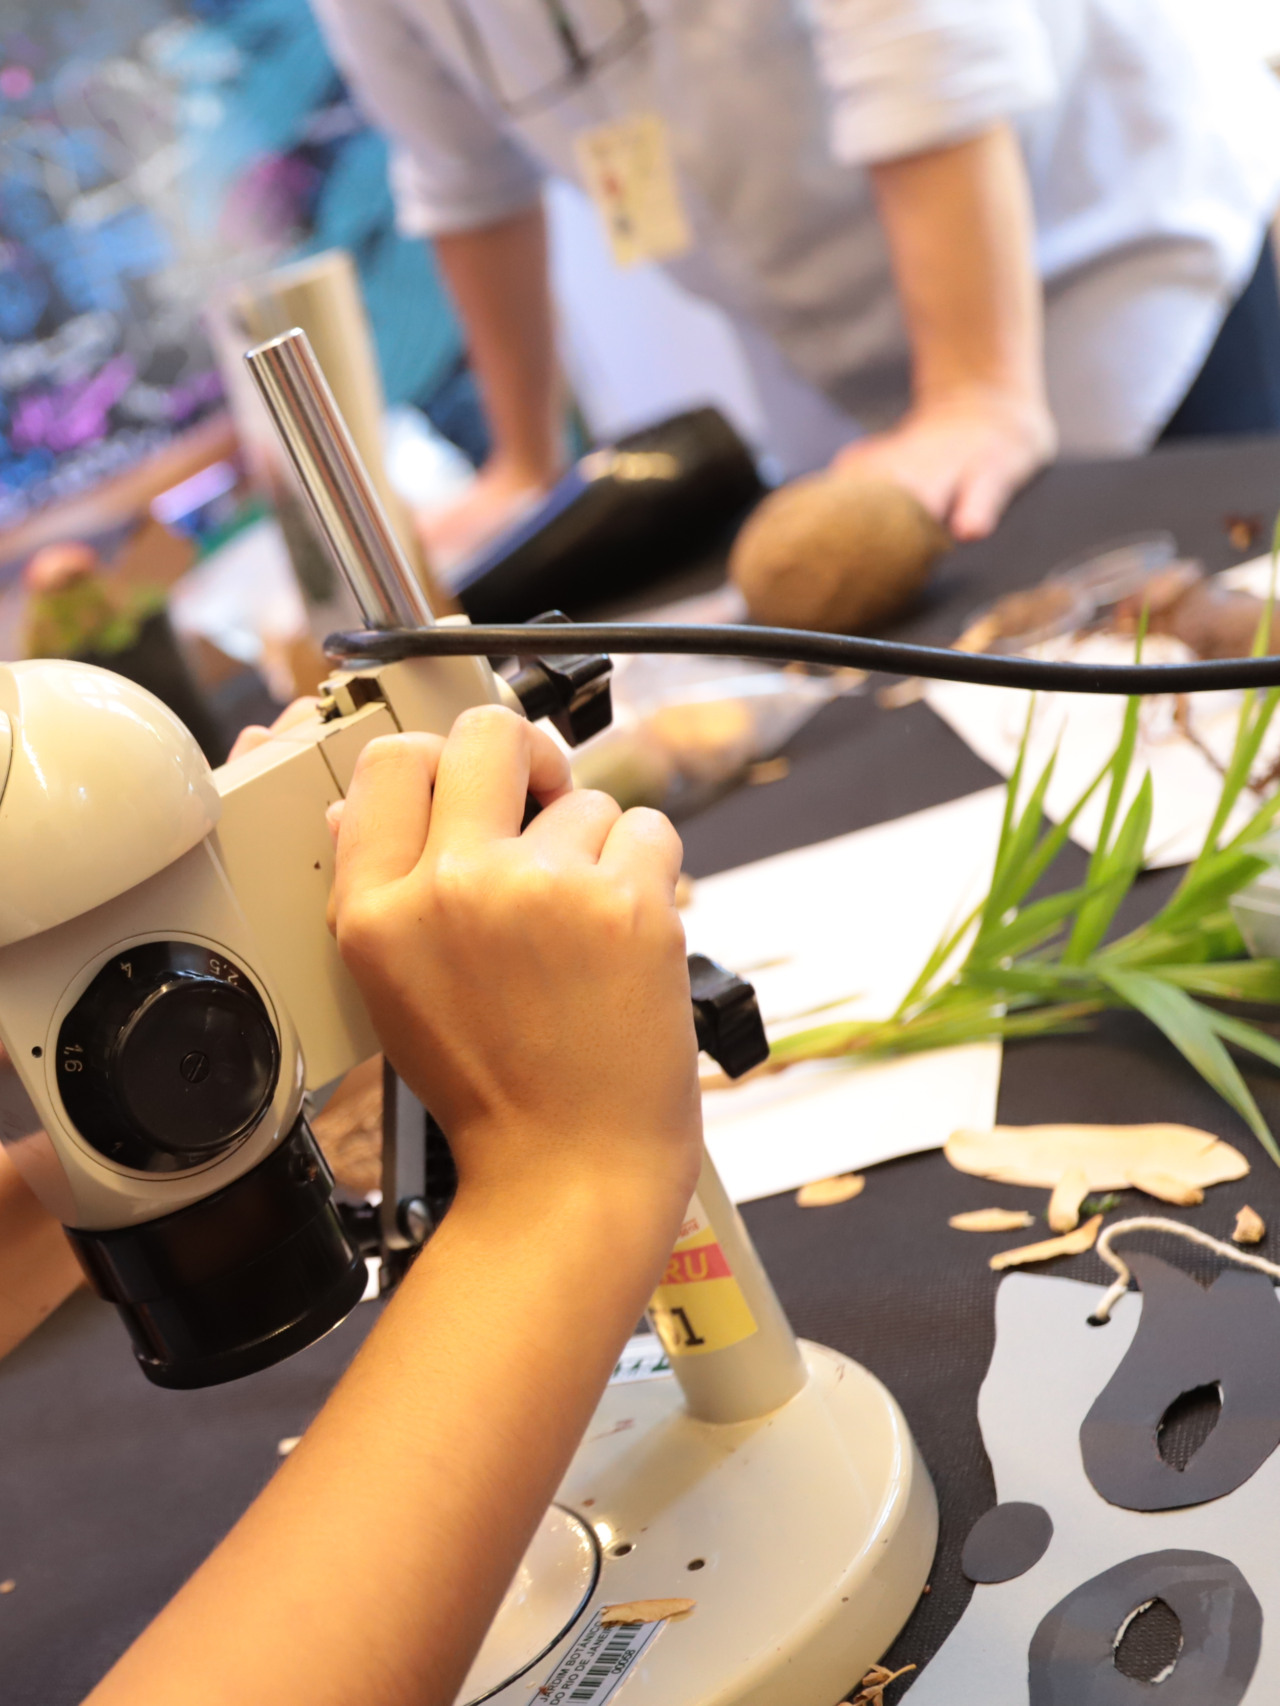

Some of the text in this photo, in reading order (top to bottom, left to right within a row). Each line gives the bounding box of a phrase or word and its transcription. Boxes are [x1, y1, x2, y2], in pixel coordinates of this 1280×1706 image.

[120, 961, 133, 979] 4
[549, 1625, 613, 1706] DO RIO DE JANEIR
[611, 1649, 636, 1674] 00058
[539, 1669, 570, 1702] JARDIM
